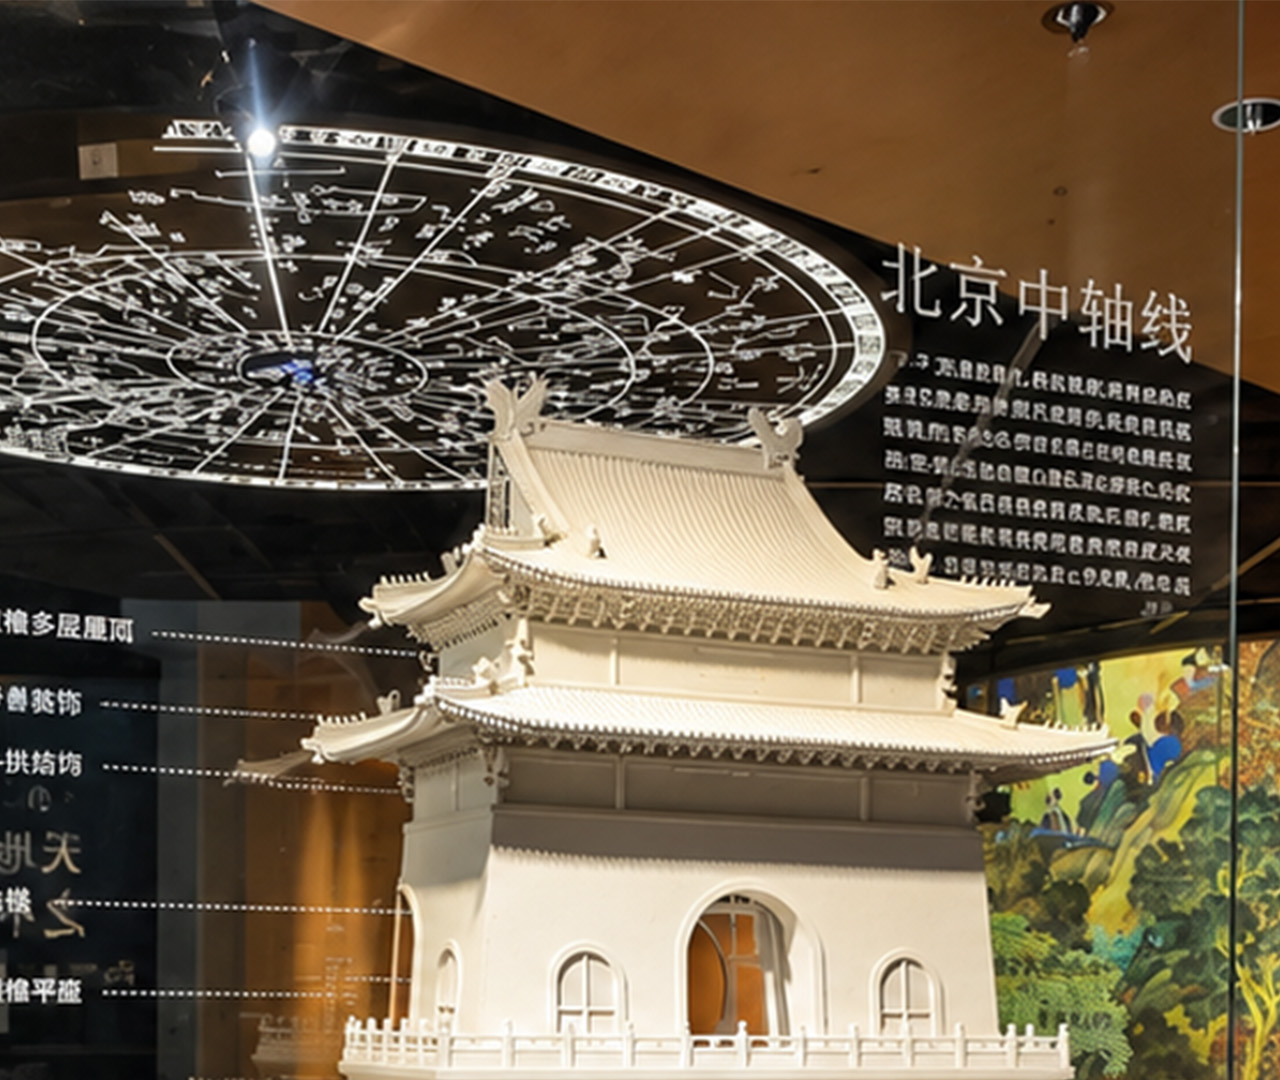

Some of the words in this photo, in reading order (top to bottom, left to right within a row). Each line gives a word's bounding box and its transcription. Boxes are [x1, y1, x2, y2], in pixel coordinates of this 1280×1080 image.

[880, 242, 1192, 364] 北京中轴线
